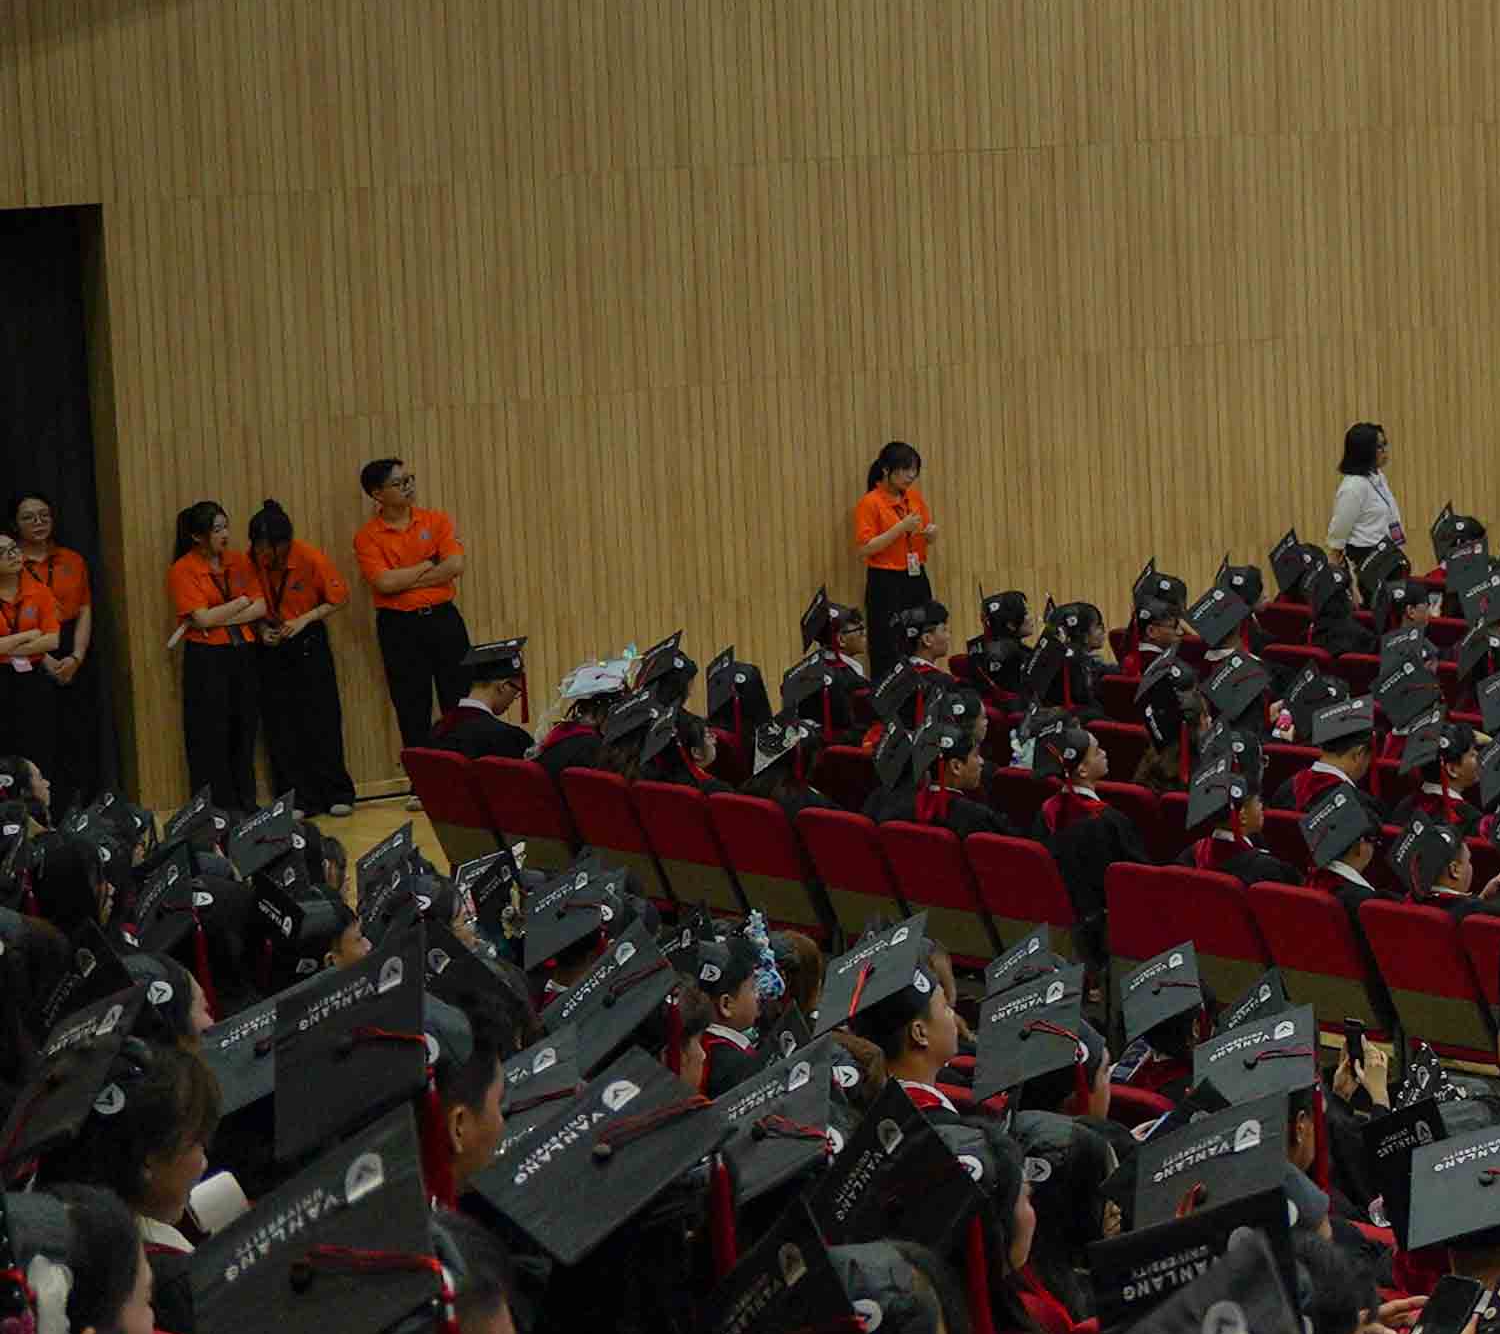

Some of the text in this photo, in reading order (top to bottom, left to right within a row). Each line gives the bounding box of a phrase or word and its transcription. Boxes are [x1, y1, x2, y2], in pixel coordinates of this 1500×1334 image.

[299, 980, 377, 1031] VANLANG
[560, 961, 619, 1019] VANLANG
[988, 992, 1047, 1024] VANLANG
[1209, 1032, 1275, 1063] VANLANG
[514, 1111, 604, 1185] VANLANG
[1153, 1135, 1235, 1184] VANLANG
[225, 1187, 340, 1282] VANLANG
